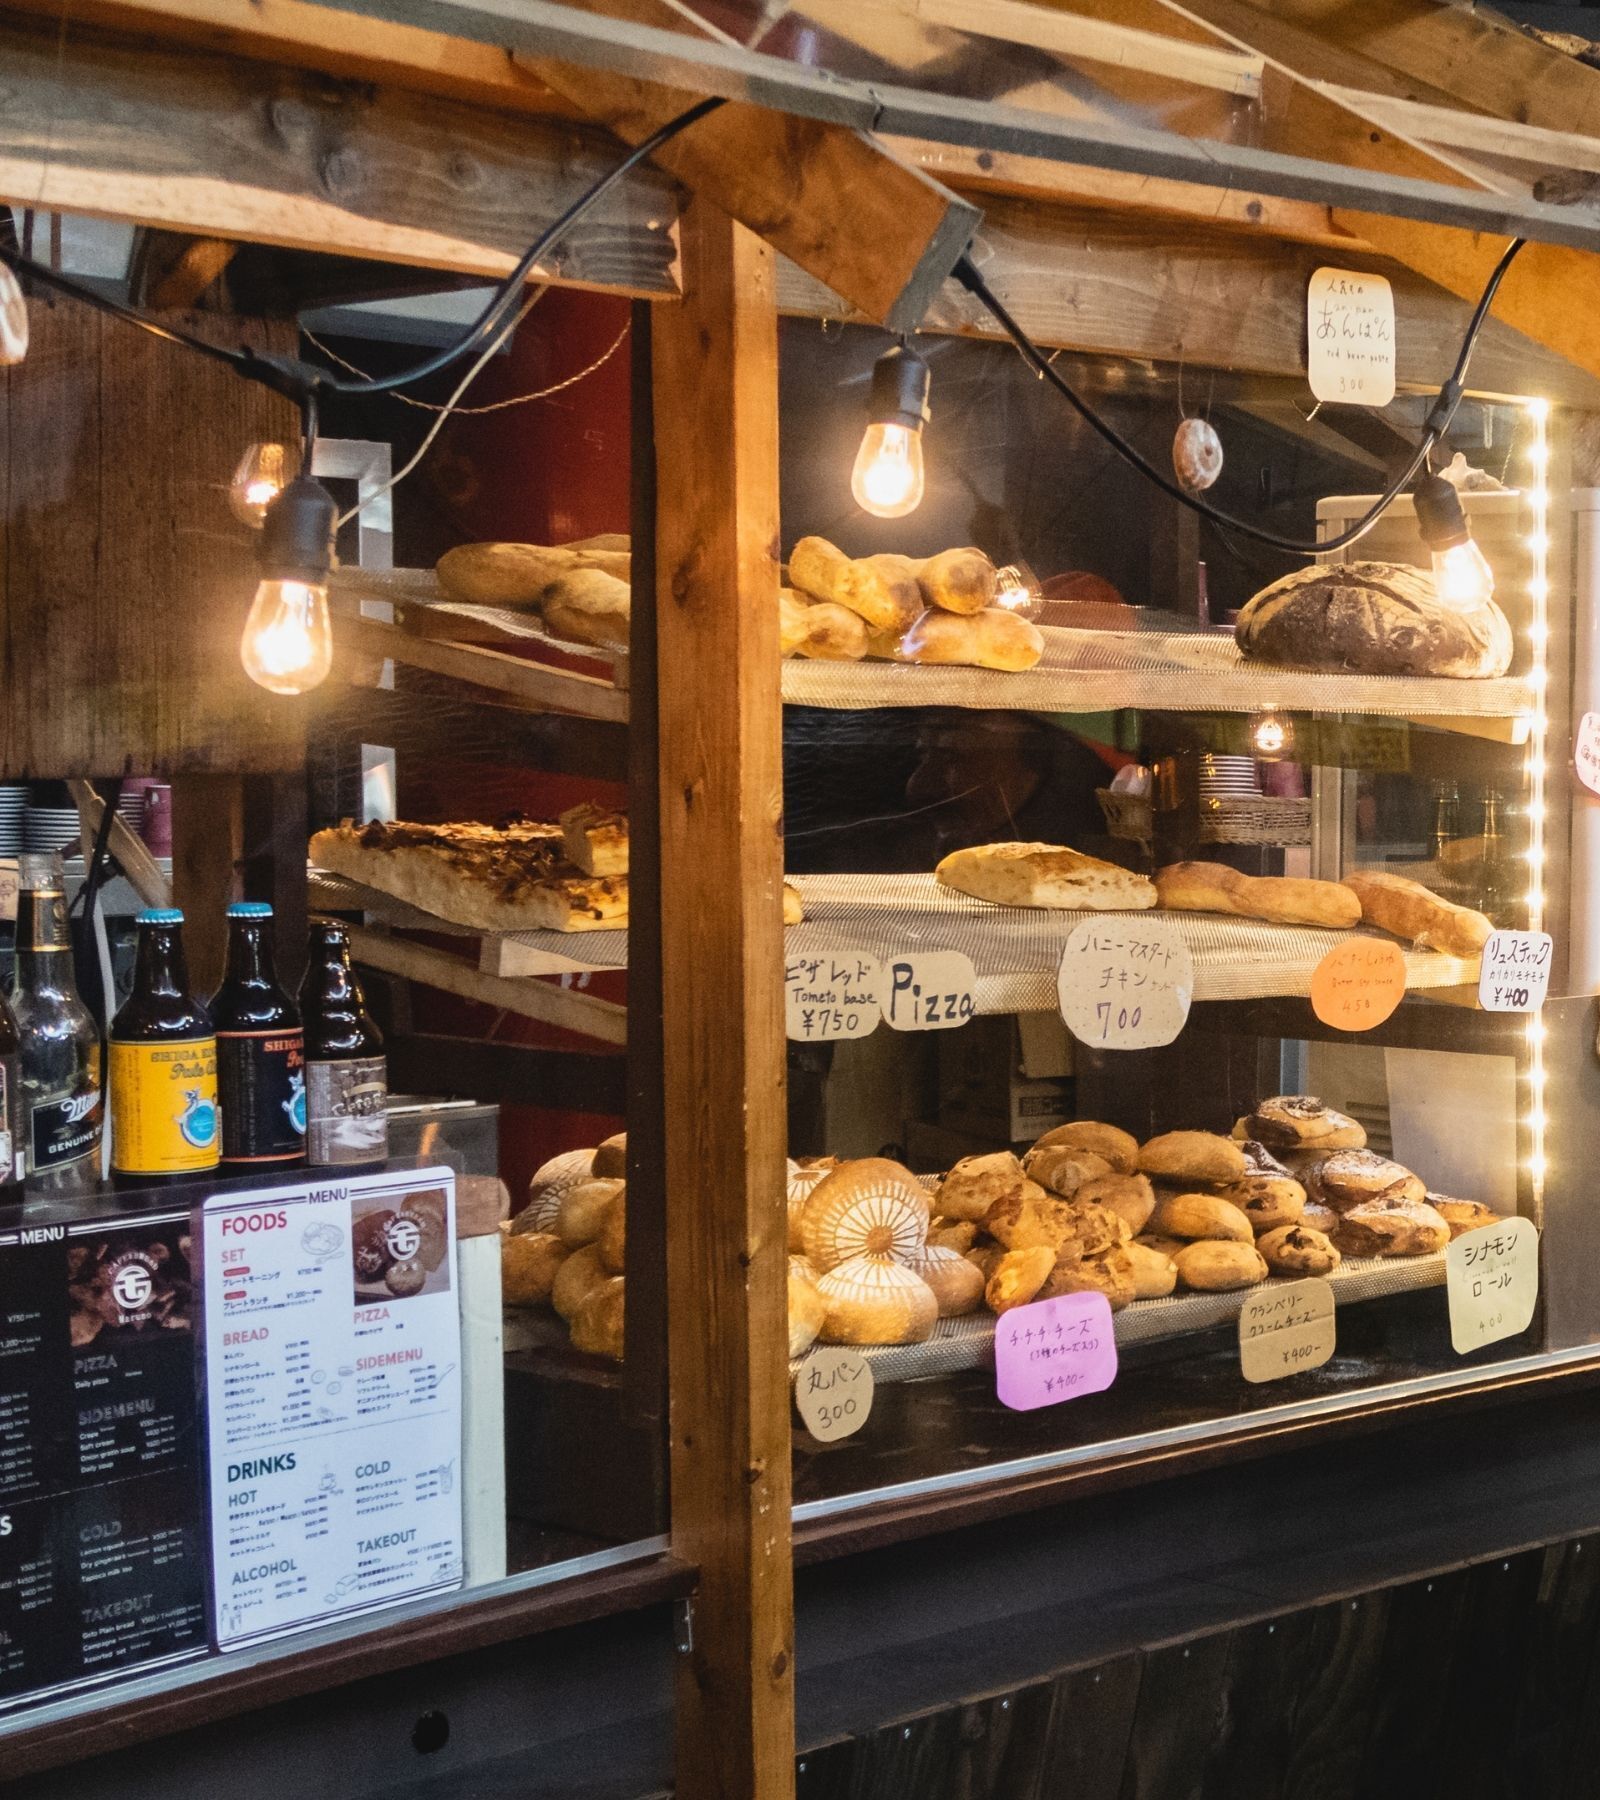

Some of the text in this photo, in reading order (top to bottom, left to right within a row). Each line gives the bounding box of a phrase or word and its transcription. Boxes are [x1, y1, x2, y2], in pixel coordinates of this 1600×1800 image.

[1316, 300, 1390, 341] あんぱん
[1081, 934, 1178, 968] ハニーマスタード
[1489, 939, 1551, 964] リュスティック
[890, 962, 976, 1025] Pizza
[1494, 987, 1529, 1006] ¥400
[801, 1009, 859, 1036] ¥750
[1096, 1001, 1142, 1039] 700
[48, 1131, 95, 1155] GENUINE
[308, 1187, 348, 1205] MENU
[21, 1226, 65, 1245] MENU
[222, 1211, 288, 1237] FOODS
[221, 1247, 246, 1264] SET
[1464, 1233, 1518, 1267] シナモン
[1472, 1272, 1513, 1298] ロール
[353, 1307, 391, 1325] PIZZA
[1249, 1308, 1317, 1338] クリームチーズ
[1479, 1312, 1504, 1334] 400
[223, 1327, 270, 1347] BREAD
[74, 1354, 118, 1375] PIZZA
[356, 1347, 424, 1373] SIDEMENU
[806, 1363, 866, 1394] 丸パン
[78, 1399, 156, 1426] SIDEMENU
[817, 1398, 857, 1429] 300
[227, 1452, 297, 1483] DRINKS
[355, 1460, 391, 1479] COLD
[228, 1490, 258, 1508] HOT
[80, 1521, 122, 1542] COLD
[357, 1528, 417, 1554] TAKEOUT
[231, 1558, 298, 1586] ALCOHOL
[82, 1594, 153, 1624] TAKEOUT
